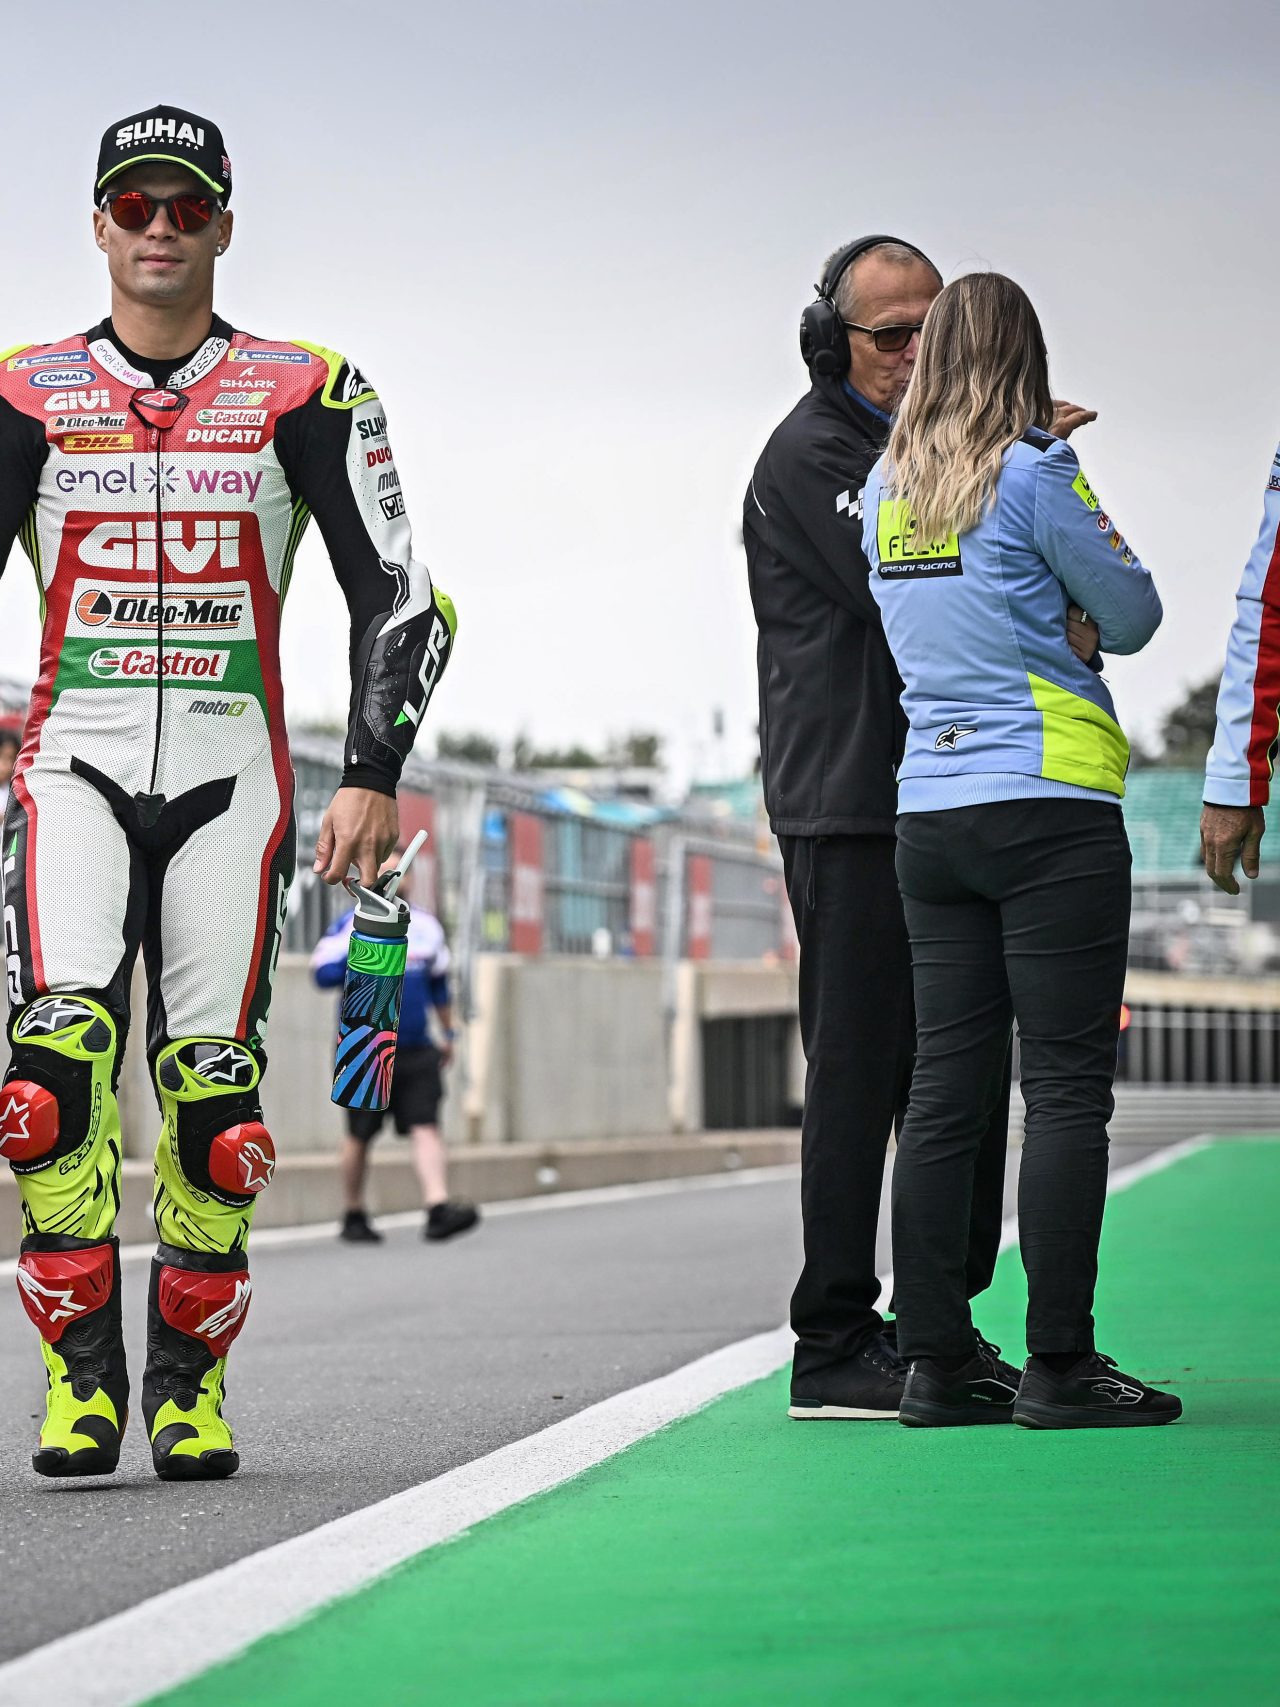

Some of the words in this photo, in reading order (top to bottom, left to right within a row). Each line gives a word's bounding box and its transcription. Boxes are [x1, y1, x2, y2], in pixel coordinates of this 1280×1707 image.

[116, 118, 205, 147] SUHAI
[120, 137, 199, 151] SEGURADORA
[31, 354, 82, 364] MICHELIN
[251, 352, 304, 362] MICHELIN
[96, 344, 116, 365] enel
[122, 368, 144, 386] way
[39, 372, 86, 383] COMAL
[219, 379, 278, 389] SHARK
[43, 389, 111, 412] GIVI
[66, 416, 126, 428] Oleo-Mac
[213, 410, 262, 424] Castrol
[72, 437, 122, 449] DHL
[186, 429, 262, 444] DUCATI
[55, 461, 137, 494] enel
[186, 469, 264, 503] way
[77, 519, 241, 575] GIVI
[880, 563, 915, 574] GRESINI
[916, 561, 957, 572] RACING
[112, 598, 243, 624] Oleo-Mac
[121, 649, 221, 677] Castrol
